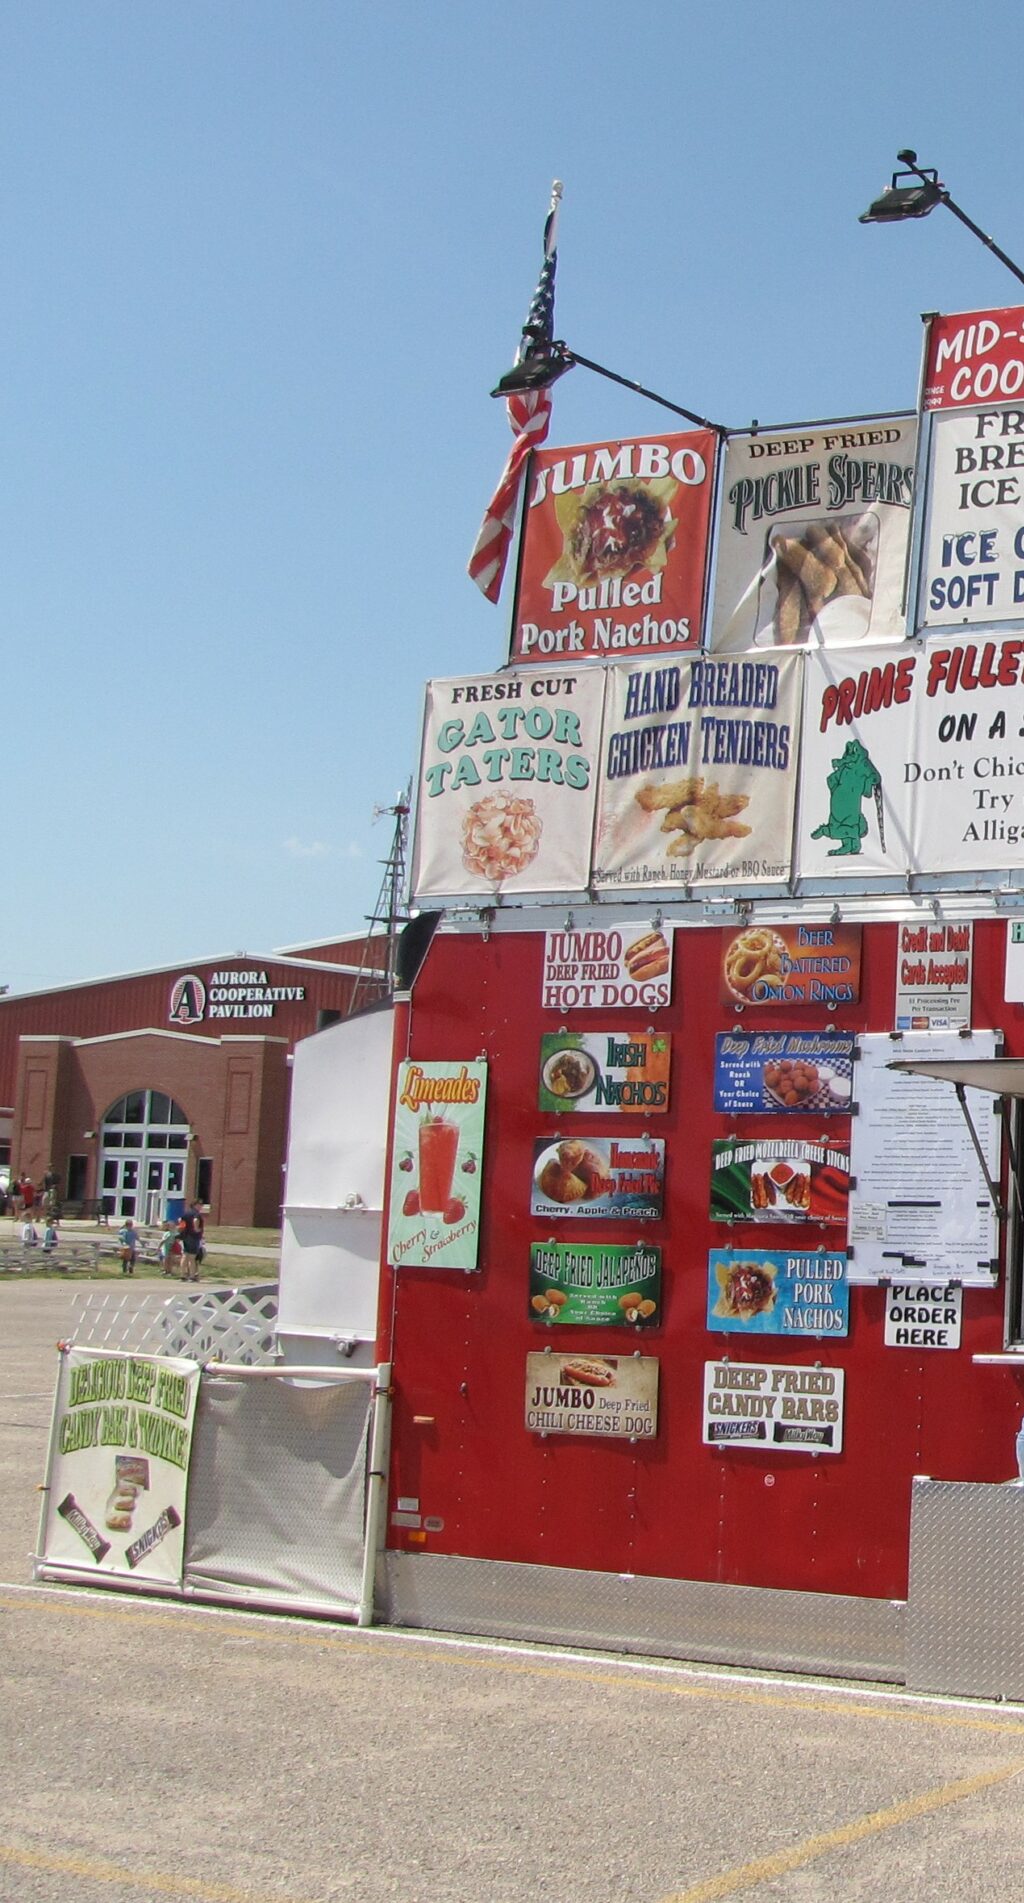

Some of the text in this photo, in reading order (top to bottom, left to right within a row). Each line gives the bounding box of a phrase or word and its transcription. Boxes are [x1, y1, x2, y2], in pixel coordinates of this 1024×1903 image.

[748, 428, 901, 458] DEEP FRIED
[530, 444, 706, 508] JUMBO
[729, 453, 916, 535] PICKLE SPEARS
[958, 476, 1022, 509] ICE
[941, 529, 999, 568] ICE
[551, 571, 662, 612] Pulled
[930, 573, 1000, 611] SOFT
[520, 615, 690, 656] Pork Nachos
[451, 677, 577, 704] FRESH CUT
[624, 661, 779, 721] HAND BREADED
[819, 656, 916, 733] PRIME
[437, 706, 583, 754] GATOR
[938, 713, 977, 743] ON
[988, 711, 1006, 739] A
[606, 716, 790, 780] CHICKEN TENDERS
[425, 747, 591, 798] TATERS
[903, 759, 965, 784] Don't
[972, 789, 1014, 815] Try
[546, 931, 622, 963] JUMBO
[798, 926, 833, 946] BEER
[901, 926, 928, 953] Credit
[929, 926, 946, 952] and
[210, 971, 268, 985] AURORA
[546, 963, 620, 981] DEEP FRIED
[780, 953, 851, 975] BATTERED
[926, 957, 968, 990] Accepted
[209, 987, 304, 1001] COOPERATIVE
[544, 983, 669, 1007] HOT DOGS
[751, 979, 854, 1000] ONION RINGS
[208, 1004, 274, 1018] PAVILION
[606, 1036, 646, 1068] IRISH
[400, 1066, 481, 1113] Limeades
[595, 1075, 667, 1106] NACHOS
[715, 1150, 733, 1170] DEEP
[734, 1144, 754, 1163] FRIED
[755, 1141, 799, 1159] MOZZARELLA
[801, 1143, 825, 1163] CHEESE
[577, 1206, 608, 1215] Apple
[611, 1207, 620, 1215] &
[622, 1207, 658, 1216] Peach
[392, 1229, 440, 1263] Cherry &
[421, 1220, 477, 1263] Strawberry
[535, 1249, 561, 1281] DEEP
[564, 1250, 594, 1288] FRIED
[785, 1257, 843, 1281] PULLED
[793, 1283, 833, 1304] PORK
[892, 1286, 955, 1302] PLACE
[783, 1307, 843, 1331] NACHOS
[889, 1306, 957, 1324] ORDER
[896, 1329, 948, 1346] HERE
[713, 1366, 836, 1395] DEEP FRIED
[531, 1386, 650, 1414] JUMBO Deep Fried
[707, 1392, 839, 1423] CANDY BARS
[527, 1411, 653, 1434] CHILI CHEESE DOG
[715, 1421, 759, 1435] SNICKERS
